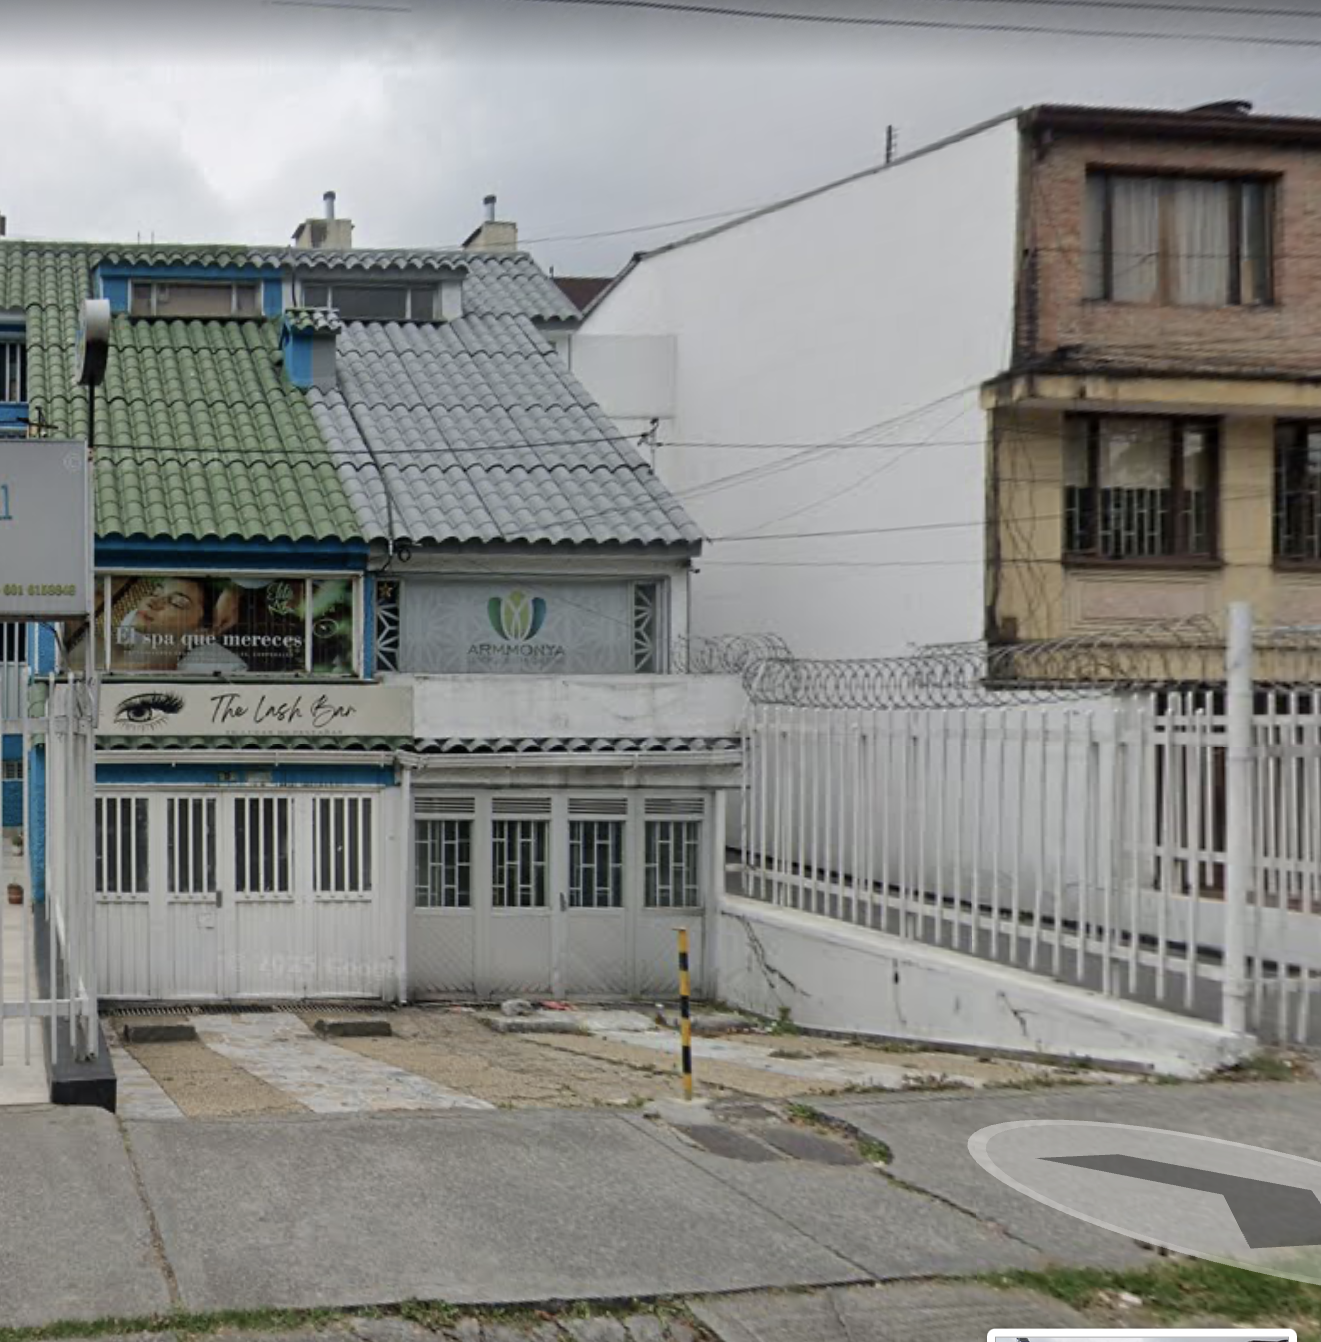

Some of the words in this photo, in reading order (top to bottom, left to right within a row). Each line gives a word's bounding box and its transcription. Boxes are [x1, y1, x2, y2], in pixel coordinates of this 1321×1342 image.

[116, 626, 136, 645] El
[143, 633, 175, 649] spa
[181, 633, 217, 649] que
[223, 634, 303, 647] mereces
[467, 643, 566, 657] ARMMONYA
[210, 693, 249, 723] The
[253, 694, 304, 723] Lash
[310, 693, 357, 728] Bar
